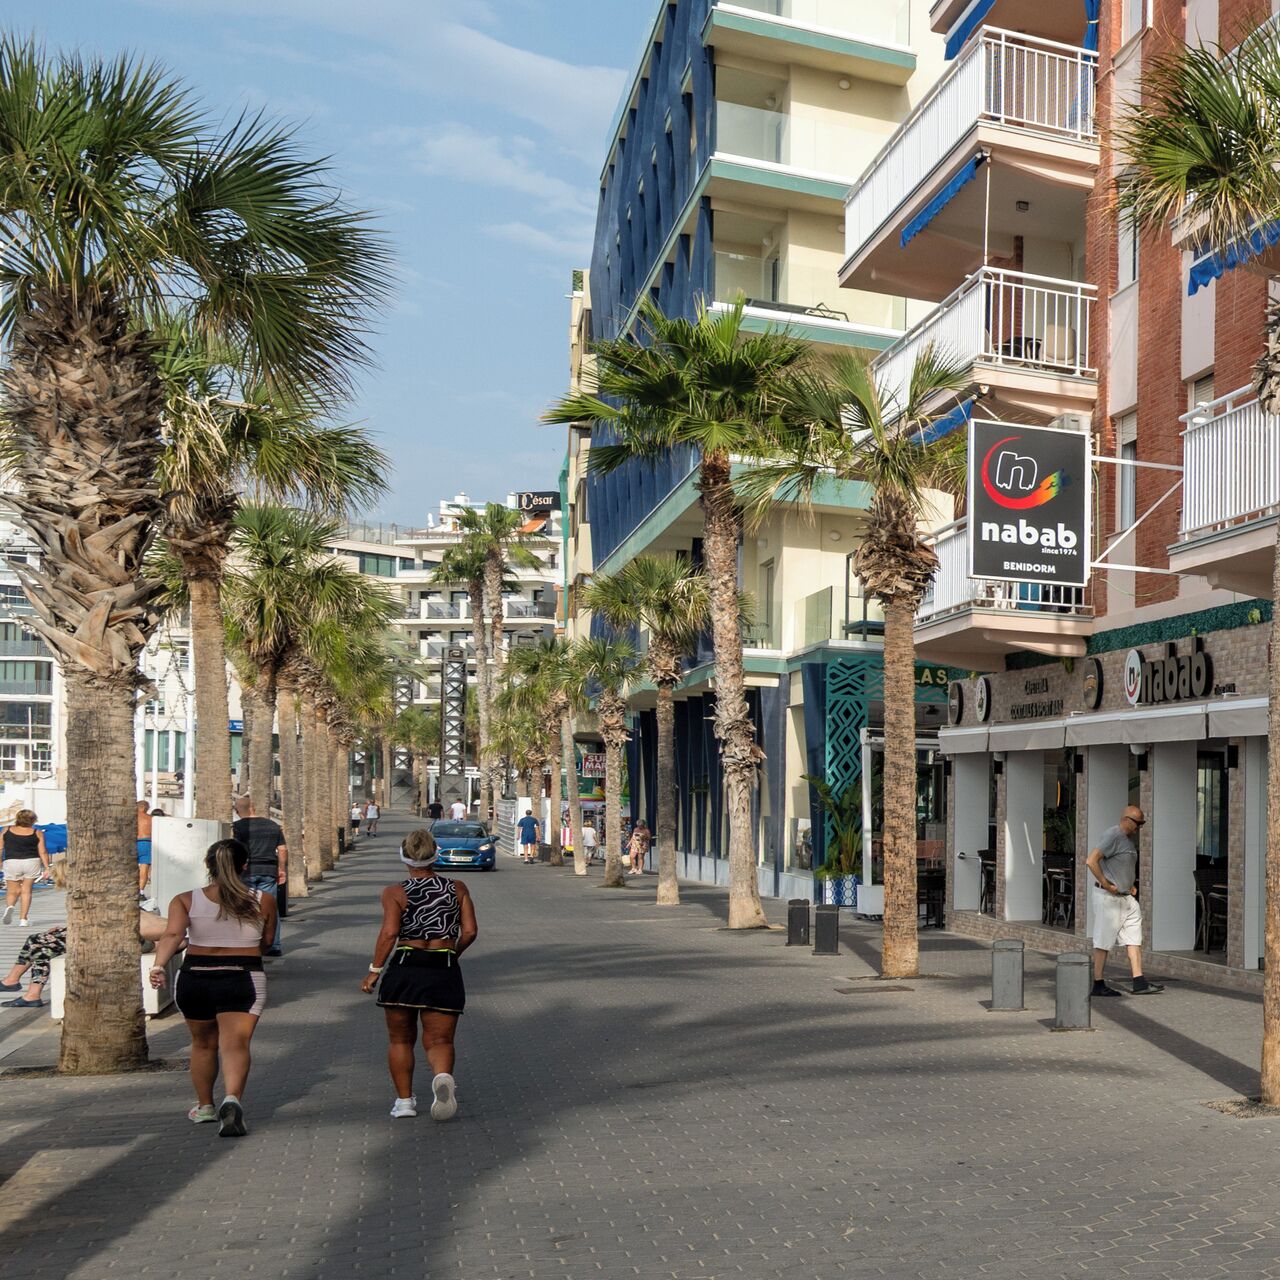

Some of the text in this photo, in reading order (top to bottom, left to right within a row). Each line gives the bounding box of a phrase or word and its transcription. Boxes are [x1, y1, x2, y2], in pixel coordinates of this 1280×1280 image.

[982, 519, 1077, 548] nabab
[1003, 561, 1056, 573] BENIDORM
[1142, 637, 1211, 703] nabab
